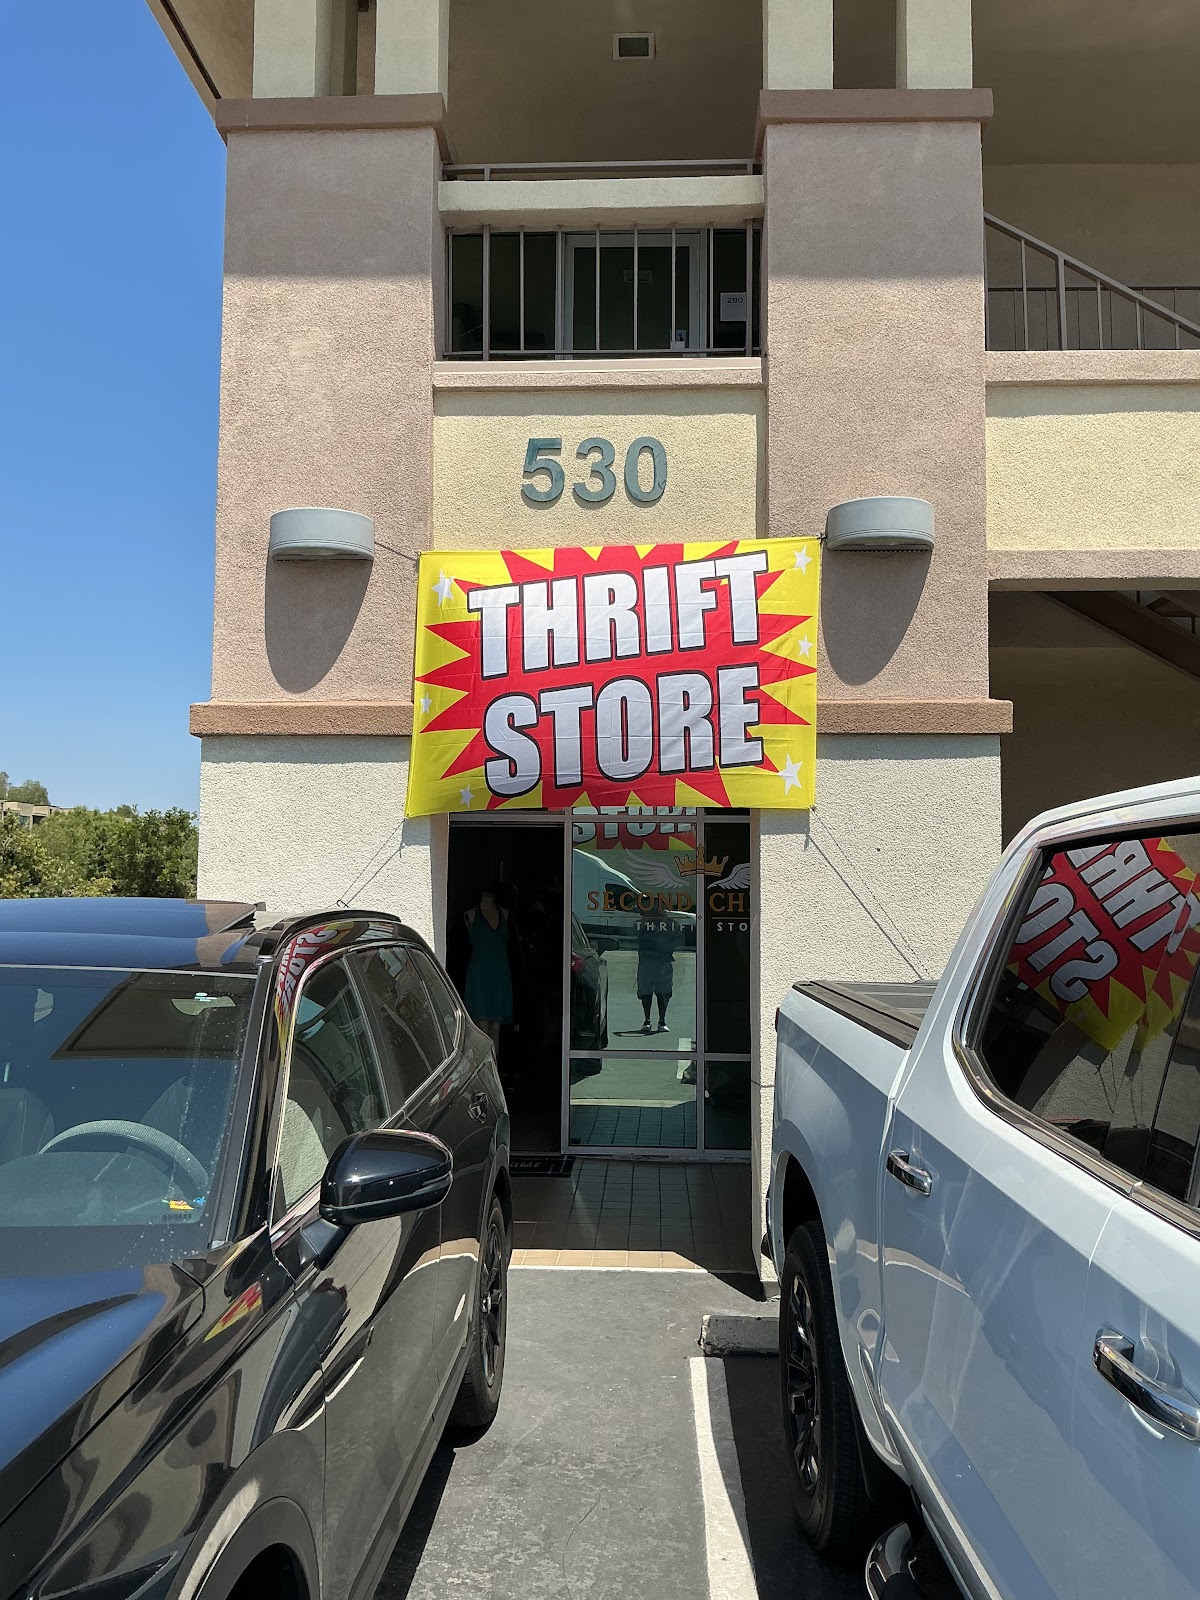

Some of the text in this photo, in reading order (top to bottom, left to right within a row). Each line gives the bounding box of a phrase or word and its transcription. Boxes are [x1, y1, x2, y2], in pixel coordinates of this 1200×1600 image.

[521, 436, 668, 503] 530
[467, 550, 768, 681] THRIFT
[484, 662, 764, 798] STORE
[587, 890, 750, 913] SECOND CH
[636, 921, 696, 932] THRIFT
